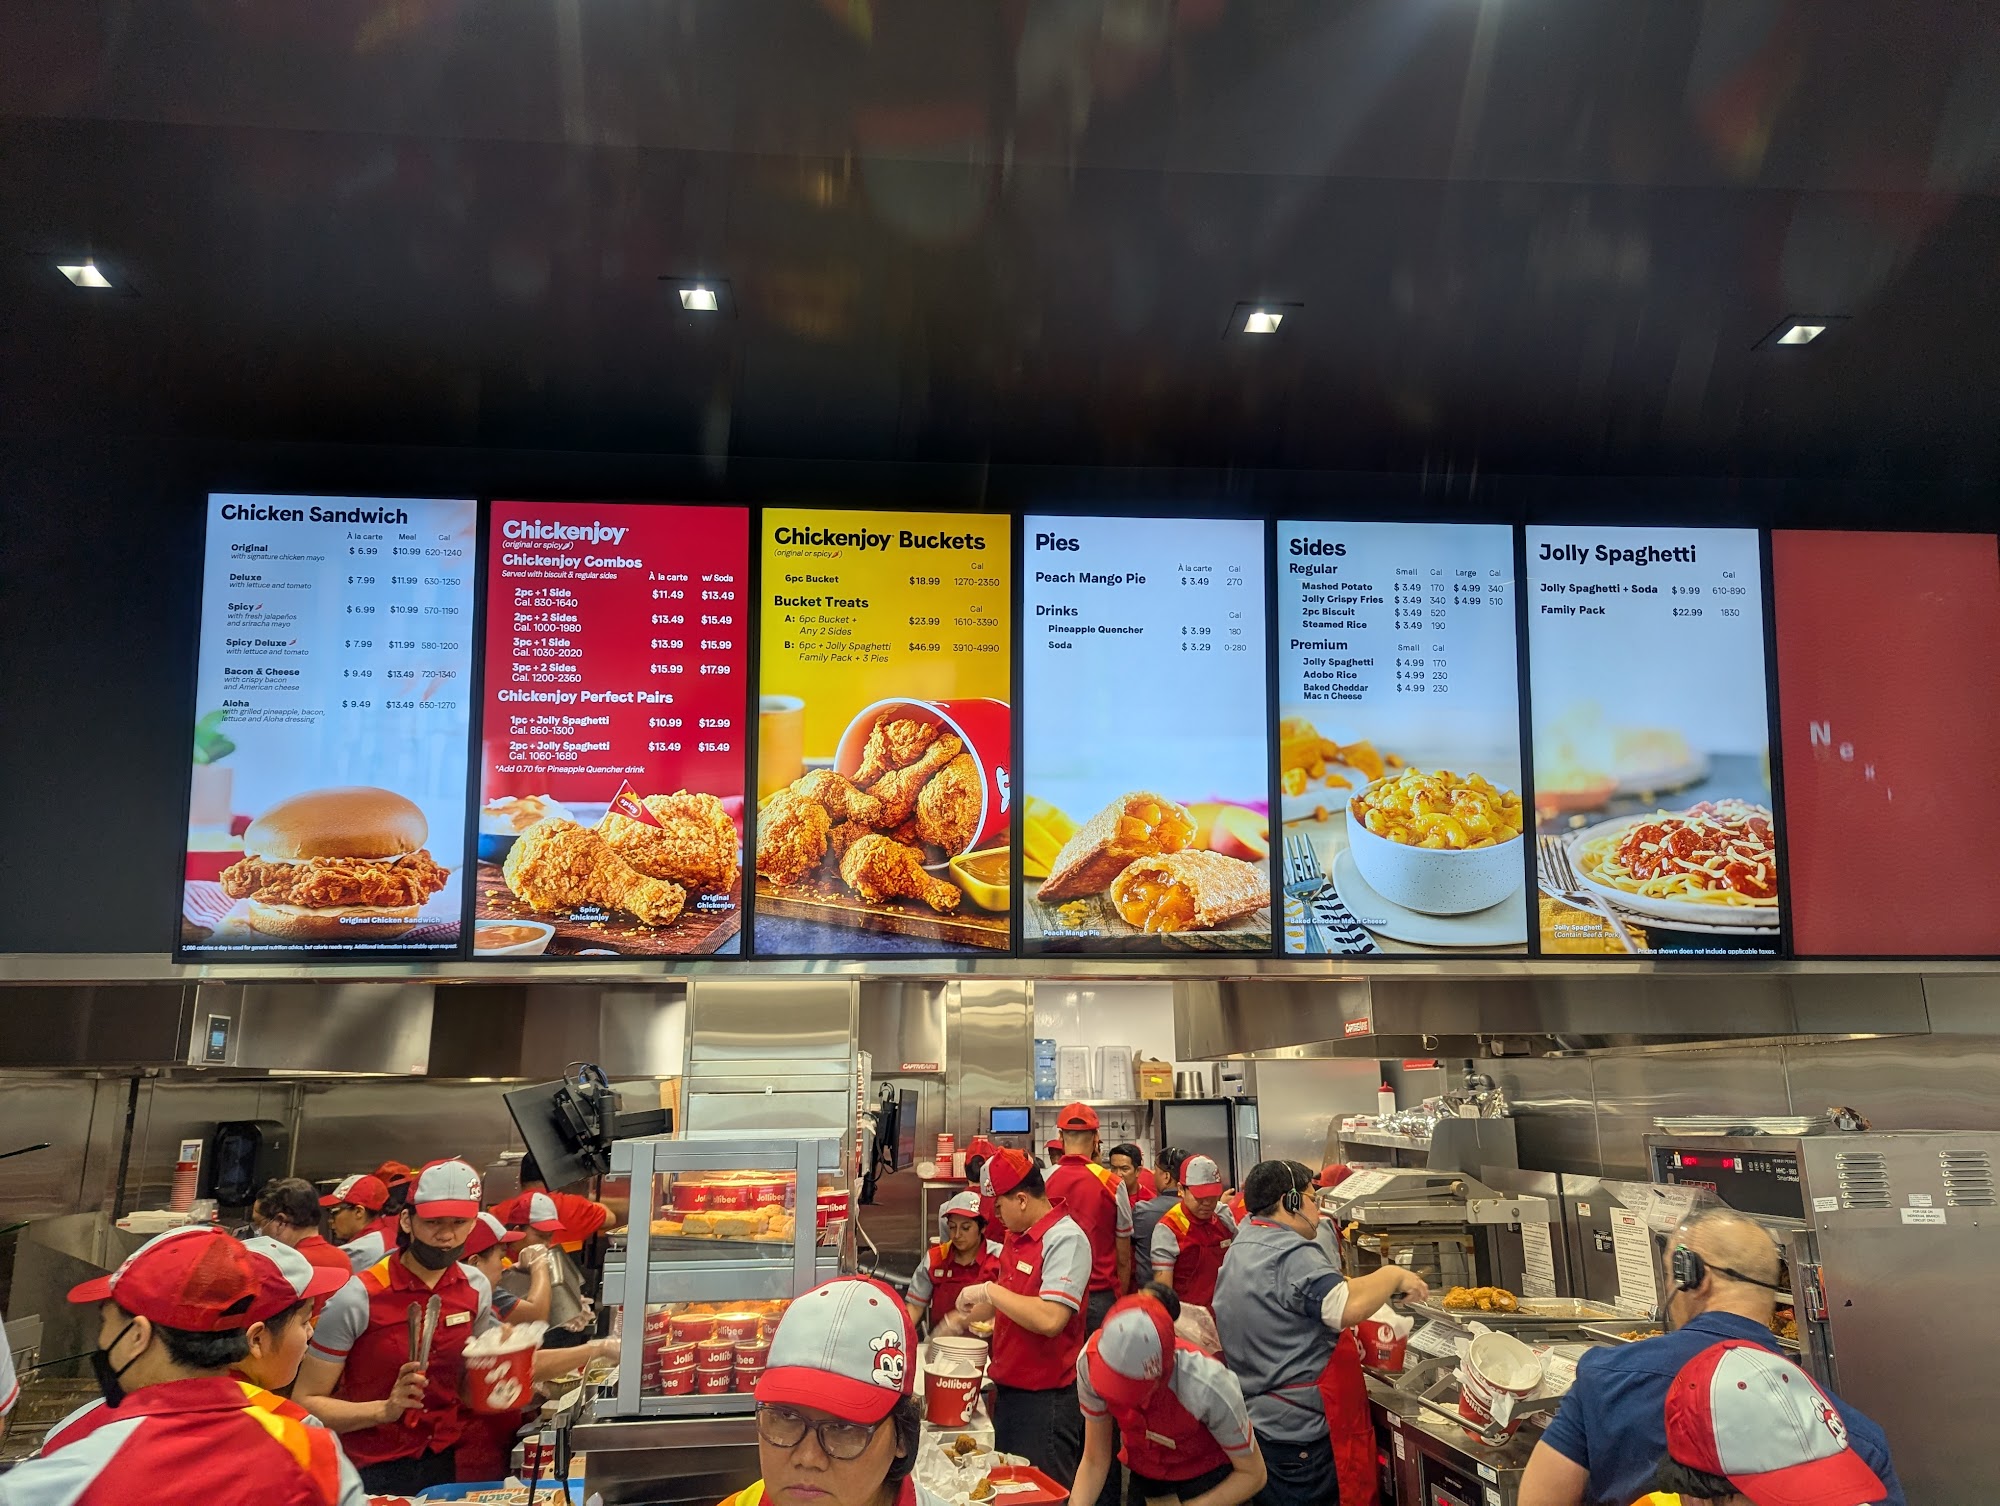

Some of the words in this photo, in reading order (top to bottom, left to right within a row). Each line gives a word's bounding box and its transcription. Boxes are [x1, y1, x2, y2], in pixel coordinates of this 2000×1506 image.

[221, 504, 304, 522] Chicken
[309, 506, 408, 524] Sandwich
[502, 520, 625, 545] Chickenjoy
[774, 527, 891, 551] Chickenjoy
[899, 531, 986, 549] Buckets
[1035, 532, 1080, 551] Pies
[231, 544, 268, 553] Original
[392, 547, 420, 556] $10.99
[1289, 537, 1346, 557] Sides
[231, 552, 245, 560] with
[246, 553, 278, 561] signature
[425, 548, 462, 556] 620-1240
[1539, 544, 1589, 564] Jolly
[1595, 545, 1696, 566] Spaghetti
[502, 554, 581, 569] Chickenjoy
[584, 556, 642, 568] Combos
[1290, 563, 1338, 576] Regular
[391, 576, 418, 585] $11.99
[424, 577, 461, 586] 630-1250
[785, 574, 804, 584] 6pc
[806, 575, 839, 583] Bucket
[909, 577, 940, 586] $18.99
[954, 578, 1000, 587] 1270-2350
[1036, 572, 1075, 583] Peach
[1079, 573, 1122, 586] Mango
[1126, 573, 1146, 584] Pie
[1302, 583, 1338, 591] Mashed
[1342, 583, 1372, 591] Potato
[1541, 584, 1566, 594] Jolly
[1569, 584, 1620, 594] Spaghetti
[1631, 585, 1658, 594] Soda
[1712, 587, 1746, 595] 610-890
[652, 590, 684, 600] $11.49
[701, 591, 734, 601] $13.49
[774, 596, 822, 607] Bucket
[825, 596, 869, 608] Treats
[1302, 595, 1324, 604] Jolly
[1326, 595, 1359, 605] Crispy
[1361, 596, 1383, 604] Fries
[228, 602, 254, 612] Spicy
[390, 606, 418, 614] $10.99
[424, 606, 458, 614] 570-1190
[1036, 605, 1078, 617] Drinks
[1541, 606, 1576, 615] Family
[1579, 606, 1606, 615] Pack
[1302, 608, 1319, 616] 2pc
[1322, 608, 1355, 616] Biscuit
[909, 617, 940, 626] $23.99
[954, 617, 998, 626] 1610-3390
[1302, 621, 1344, 629] Steamed
[1346, 621, 1367, 629] Rice
[800, 627, 818, 636] Any
[820, 627, 826, 635] 2
[828, 627, 852, 636] Sides
[1048, 625, 1095, 634] Pineapple
[1098, 626, 1143, 634] Quencher
[226, 638, 252, 648] Spicy
[254, 639, 286, 647] Deluxe
[388, 640, 415, 649] $11.99
[421, 641, 458, 650] 580-1200
[784, 641, 794, 649] B:
[799, 641, 816, 651] 6pc
[825, 641, 847, 651] Jolly
[849, 642, 891, 652] Spaghetti
[909, 642, 940, 652] $46.99
[1048, 641, 1072, 649] Soda
[1291, 639, 1348, 650] Premium
[953, 644, 1000, 652] 3910-4990
[799, 653, 828, 663] Family
[830, 654, 853, 662] Pack
[862, 654, 869, 662] 3
[871, 654, 889, 663] Pies
[1303, 658, 1326, 667] Jolly
[1329, 658, 1374, 667] Spaghetti
[224, 668, 253, 676] Bacon
[256, 668, 263, 676] &
[265, 668, 300, 676] Cheese
[650, 664, 683, 674] $15.99
[700, 665, 730, 675] $17.99
[387, 670, 414, 678] $13.49
[421, 670, 456, 678] 720-1340
[1303, 671, 1334, 679] Adobo
[1336, 671, 1357, 679] Rice
[1303, 684, 1330, 692] Baked
[1332, 684, 1368, 692] Cheddar
[498, 690, 577, 704] Chickenjoy
[580, 691, 633, 703] Perfect
[637, 692, 673, 703] Pairs
[1304, 692, 1322, 700] Mac
[1331, 692, 1362, 700] Cheese
[386, 700, 414, 709] $13.49
[419, 701, 456, 710] 650-1270
[649, 718, 682, 728] $10.99
[699, 719, 730, 729] $12.99
[648, 742, 681, 752] $13.49
[698, 743, 730, 752] $15.49
[516, 765, 533, 773] 0.70
[534, 765, 545, 773] for
[547, 765, 584, 774] Pineapple
[586, 766, 623, 774] Quencher
[625, 766, 645, 774] drink
[620, 798, 638, 814] spicy
[702, 894, 729, 902] Original
[579, 906, 600, 914] Spicy
[697, 902, 735, 910] Chickenjoy
[570, 914, 609, 922] Chickenjoy
[936, 1378, 971, 1389] Jollibee
